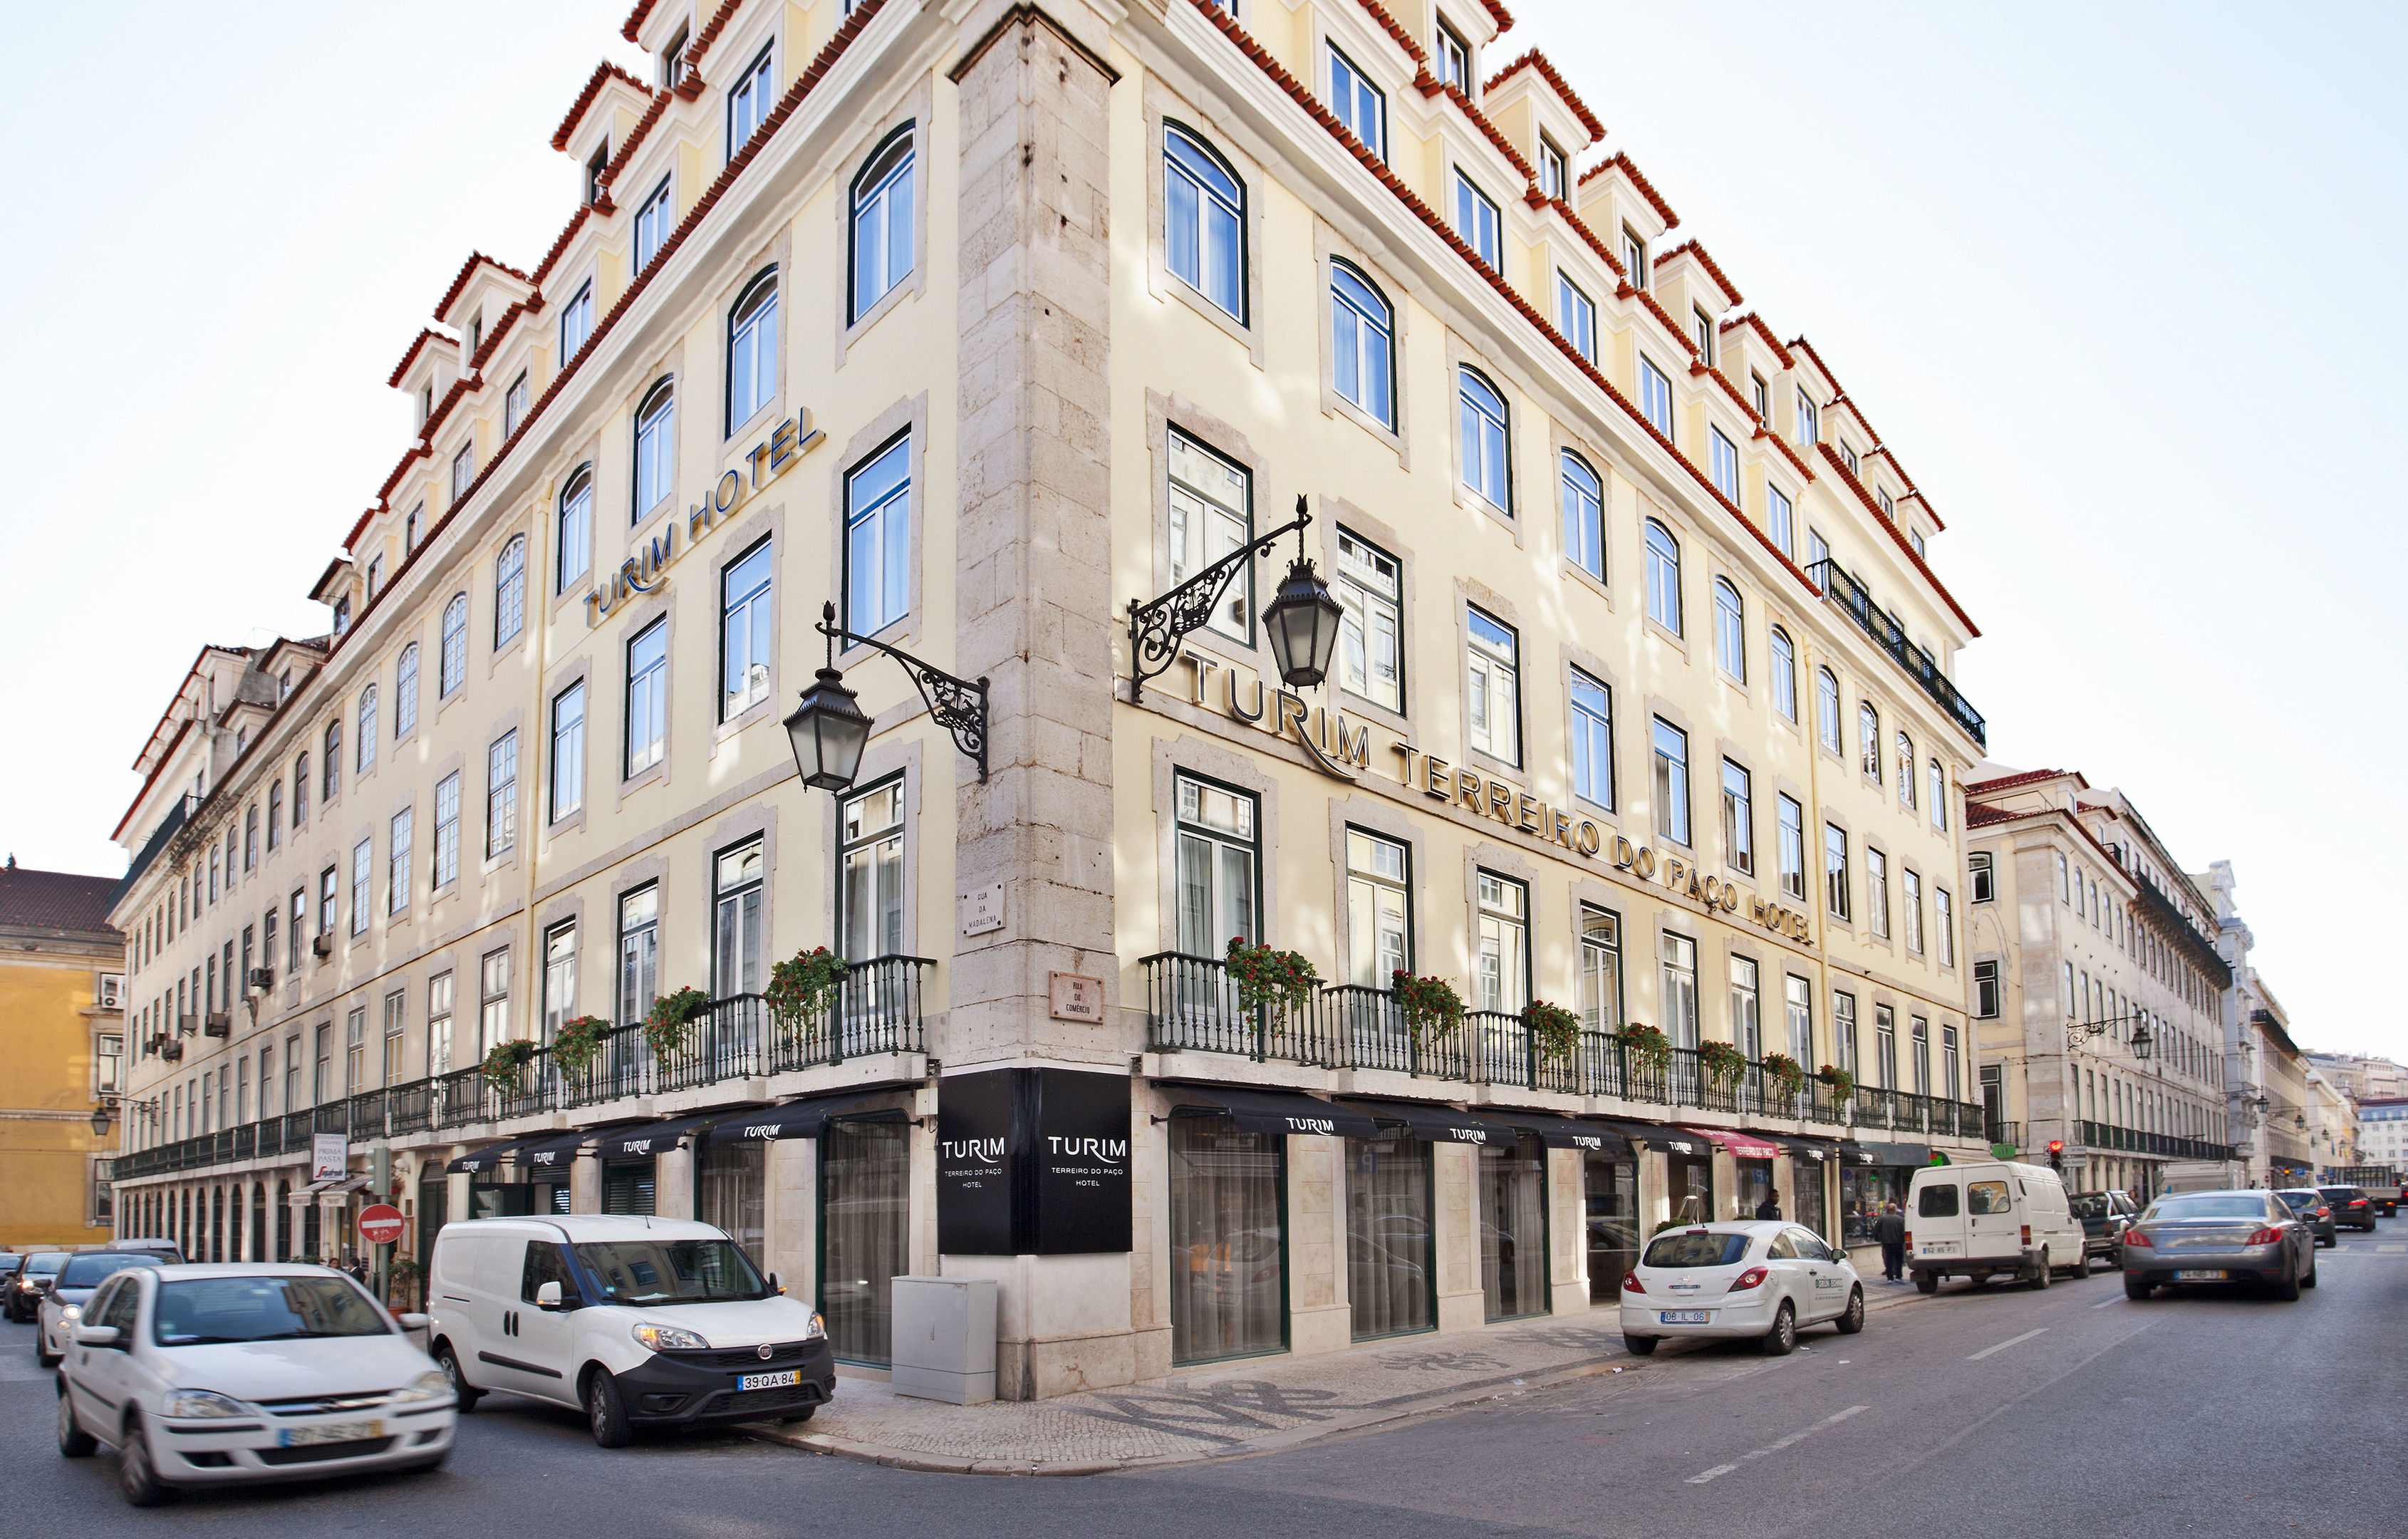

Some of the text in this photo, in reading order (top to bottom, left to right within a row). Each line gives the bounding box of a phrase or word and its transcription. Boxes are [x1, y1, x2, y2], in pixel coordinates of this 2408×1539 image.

[583, 405, 826, 628] TURIM HOTEL
[1179, 649, 1815, 945] TURIM TERREIRO DO PAÇO HOTEL
[977, 892, 987, 901] RUA
[968, 915, 997, 928] MADALENA
[1066, 1004, 1090, 1014] COMÉRCIO
[744, 1124, 782, 1140] TURIM
[1285, 1116, 1334, 1136] TURIM
[1449, 1128, 1486, 1145] TURIM
[1572, 1136, 1602, 1151] TURIM
[623, 1139, 651, 1155] TURIM
[942, 1137, 1005, 1164] TURIM
[1048, 1136, 1126, 1164] TURIM
[1668, 1141, 1692, 1155] TURIM
[534, 1151, 555, 1166] TURIM
[462, 1161, 479, 1173] TURIM
